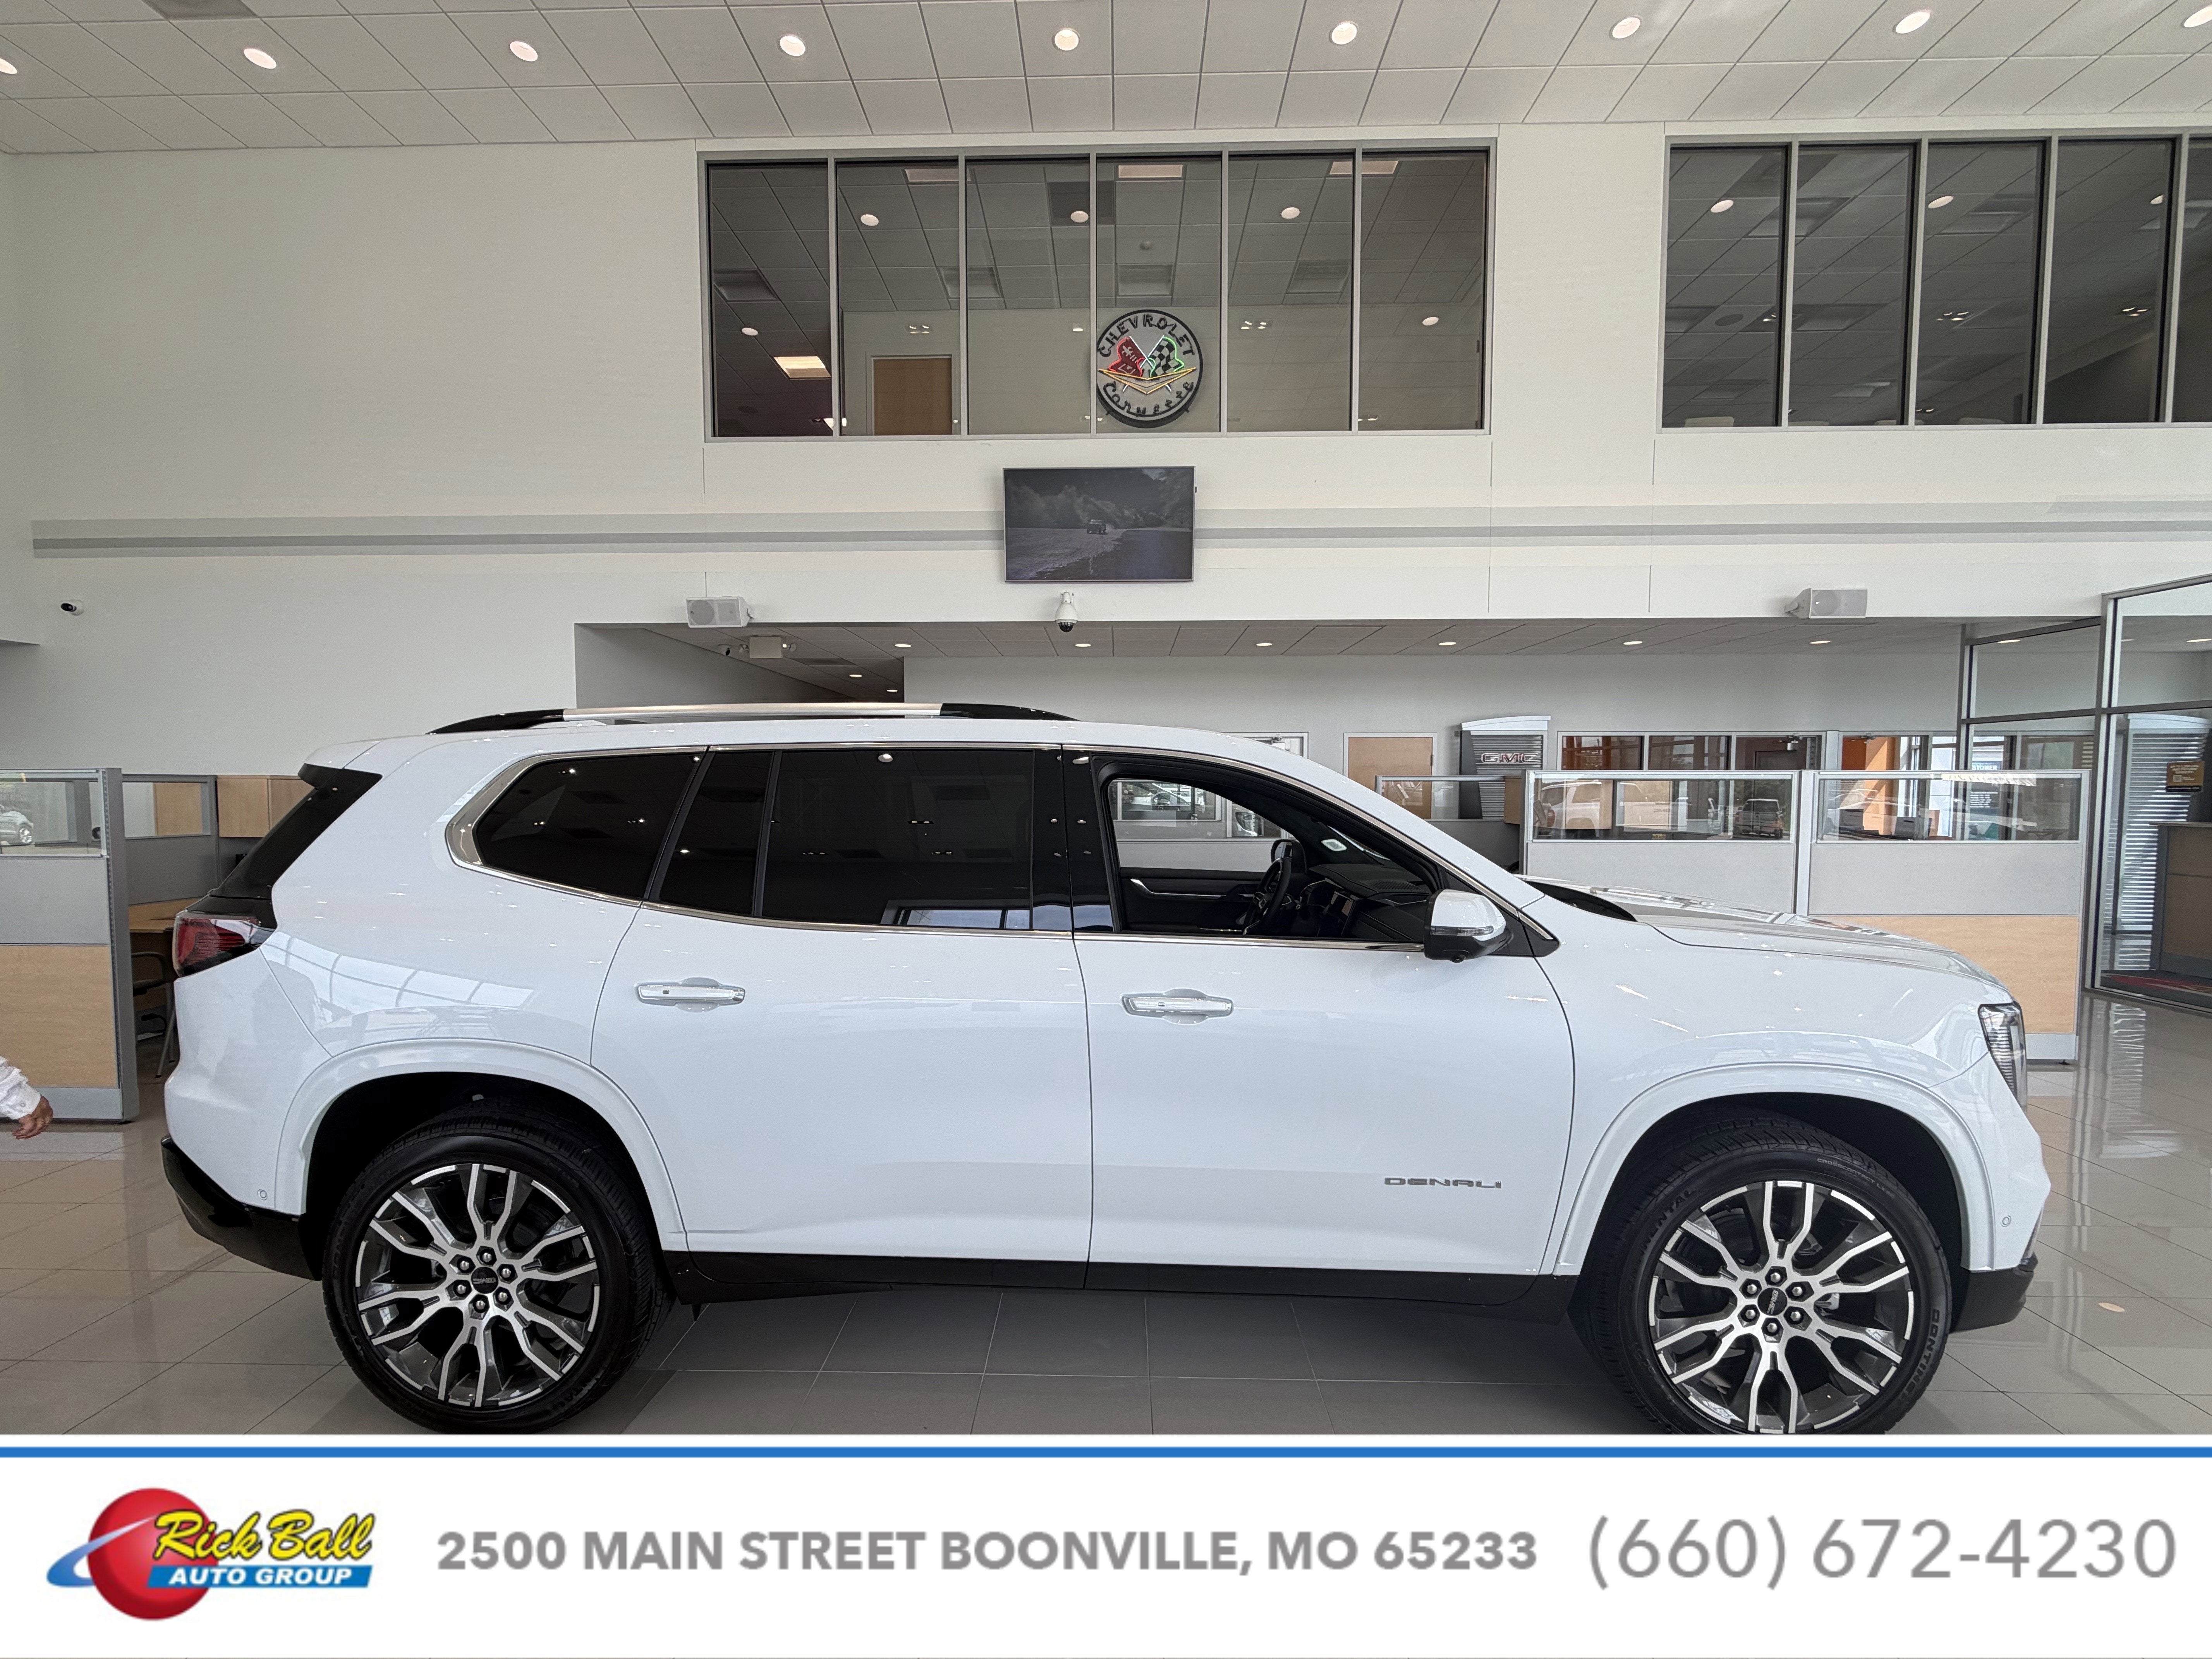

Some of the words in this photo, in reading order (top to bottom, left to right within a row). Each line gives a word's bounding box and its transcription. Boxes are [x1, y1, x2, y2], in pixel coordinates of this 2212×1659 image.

[1097, 314, 1195, 357] CHEVROLET
[1103, 381, 1194, 417] Corvette
[1481, 753, 1539, 763] GMC
[1384, 1177, 1502, 1188] DENALI
[1817, 1158, 1875, 1183] CROSSCONTACT
[1767, 1290, 1779, 1314] GMC
